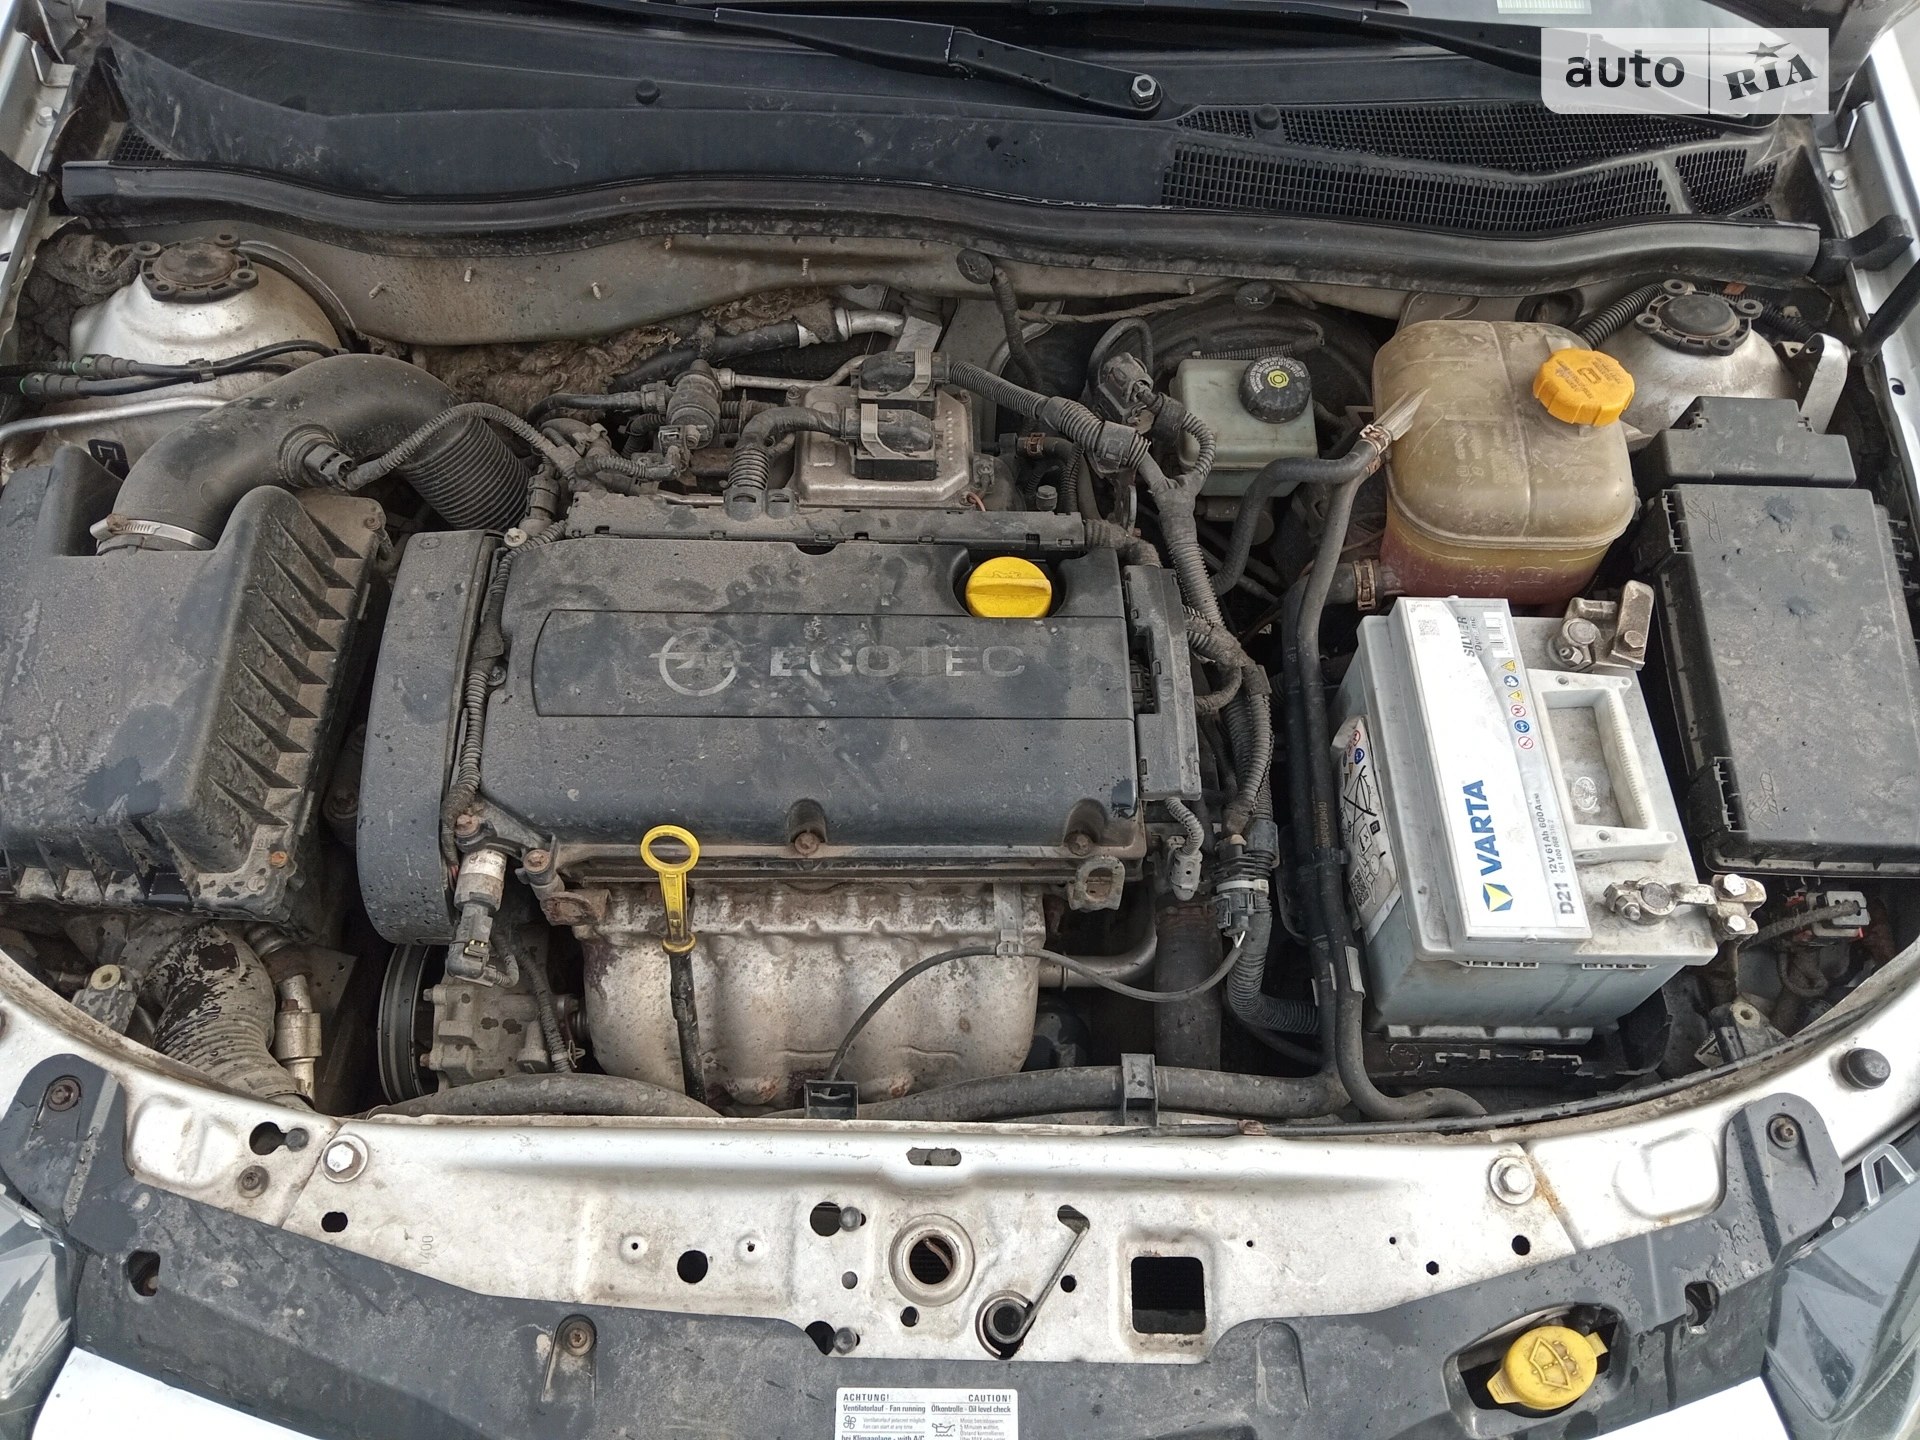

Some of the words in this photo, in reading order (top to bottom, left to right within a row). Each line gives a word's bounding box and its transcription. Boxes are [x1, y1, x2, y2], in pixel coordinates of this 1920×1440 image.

[1456, 616, 1476, 657] SILVER
[770, 645, 1025, 677] ECOTEC
[1462, 780, 1502, 876] VARTA
[1554, 883, 1575, 914] D21
[843, 1394, 890, 1402] ACHTUNG!
[968, 1394, 1011, 1403] CAUTION!
[902, 1405, 926, 1414] running
[931, 1404, 963, 1413] Ölkontrolle
